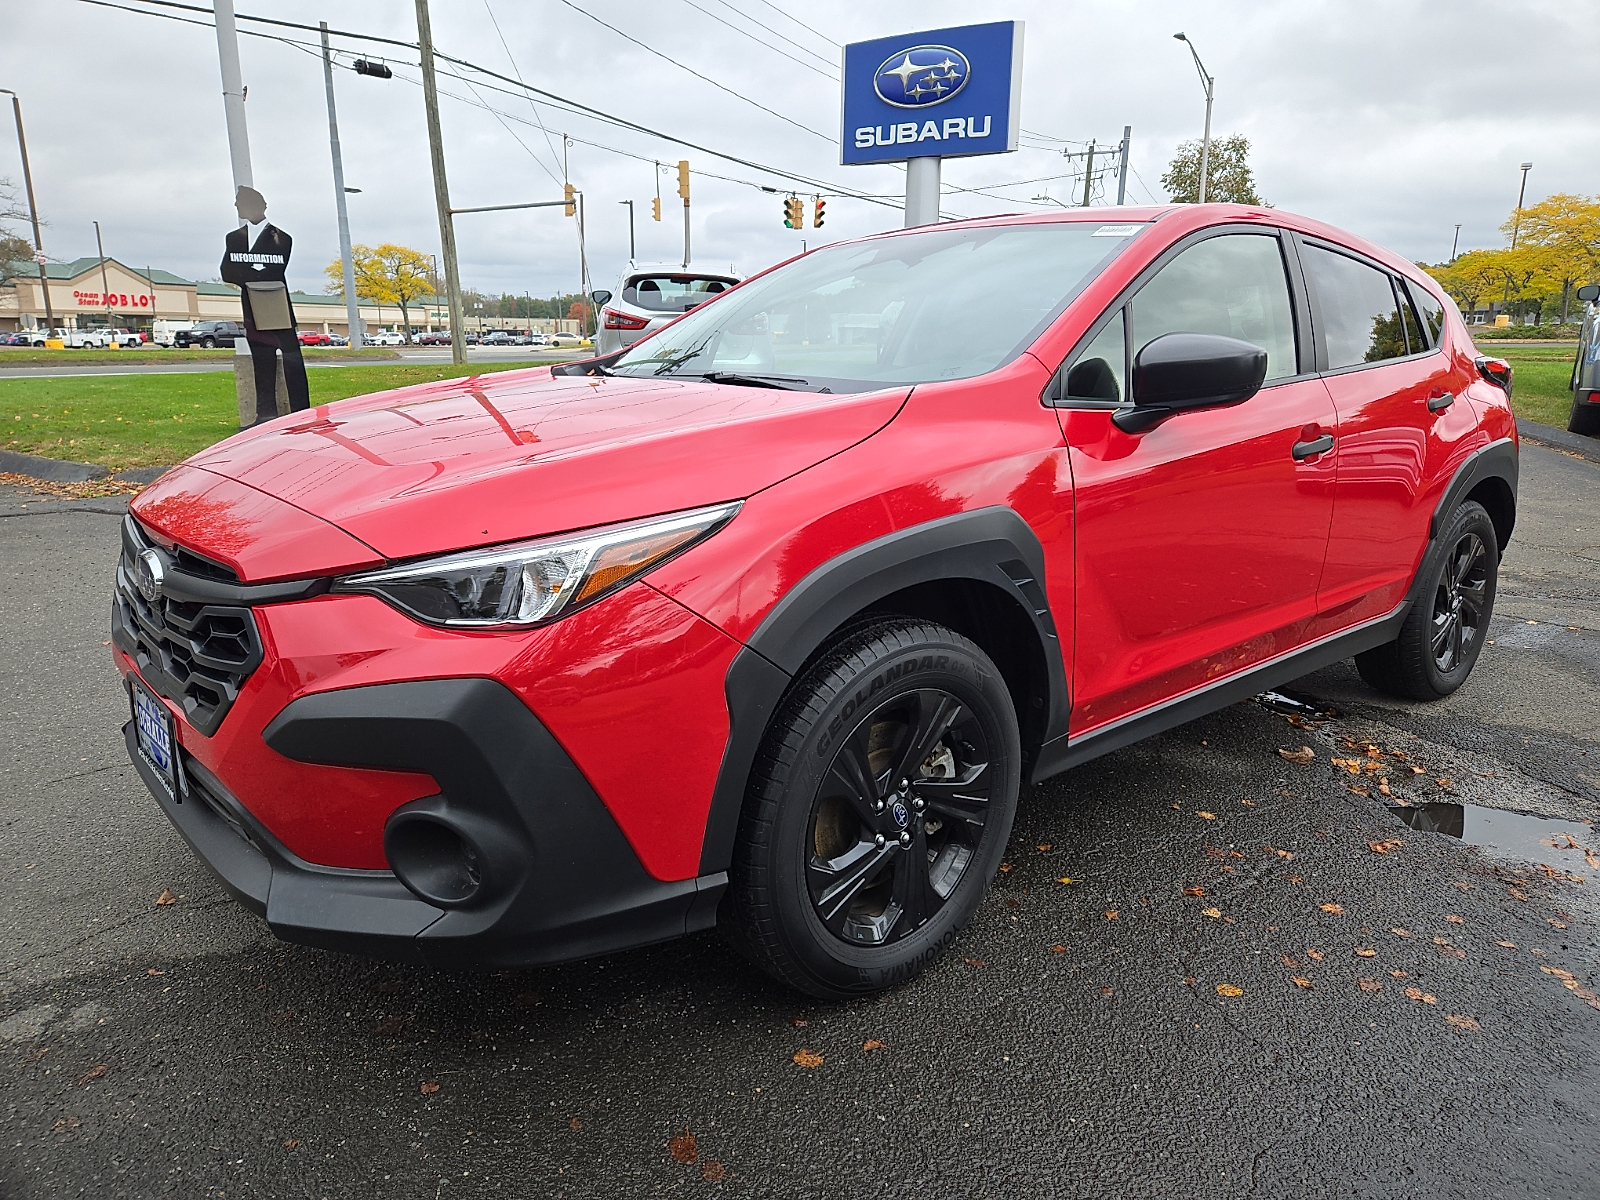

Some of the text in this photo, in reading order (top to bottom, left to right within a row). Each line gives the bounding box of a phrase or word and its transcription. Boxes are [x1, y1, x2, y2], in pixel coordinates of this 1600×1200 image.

[855, 115, 992, 148] SUBARU
[229, 252, 285, 264] INFORMATION
[73, 290, 99, 299] Ocean
[101, 293, 156, 307] JOB LOT
[78, 298, 100, 306] State
[816, 655, 950, 758] GEOLANDAR
[880, 924, 961, 983] YOKOHAMA
